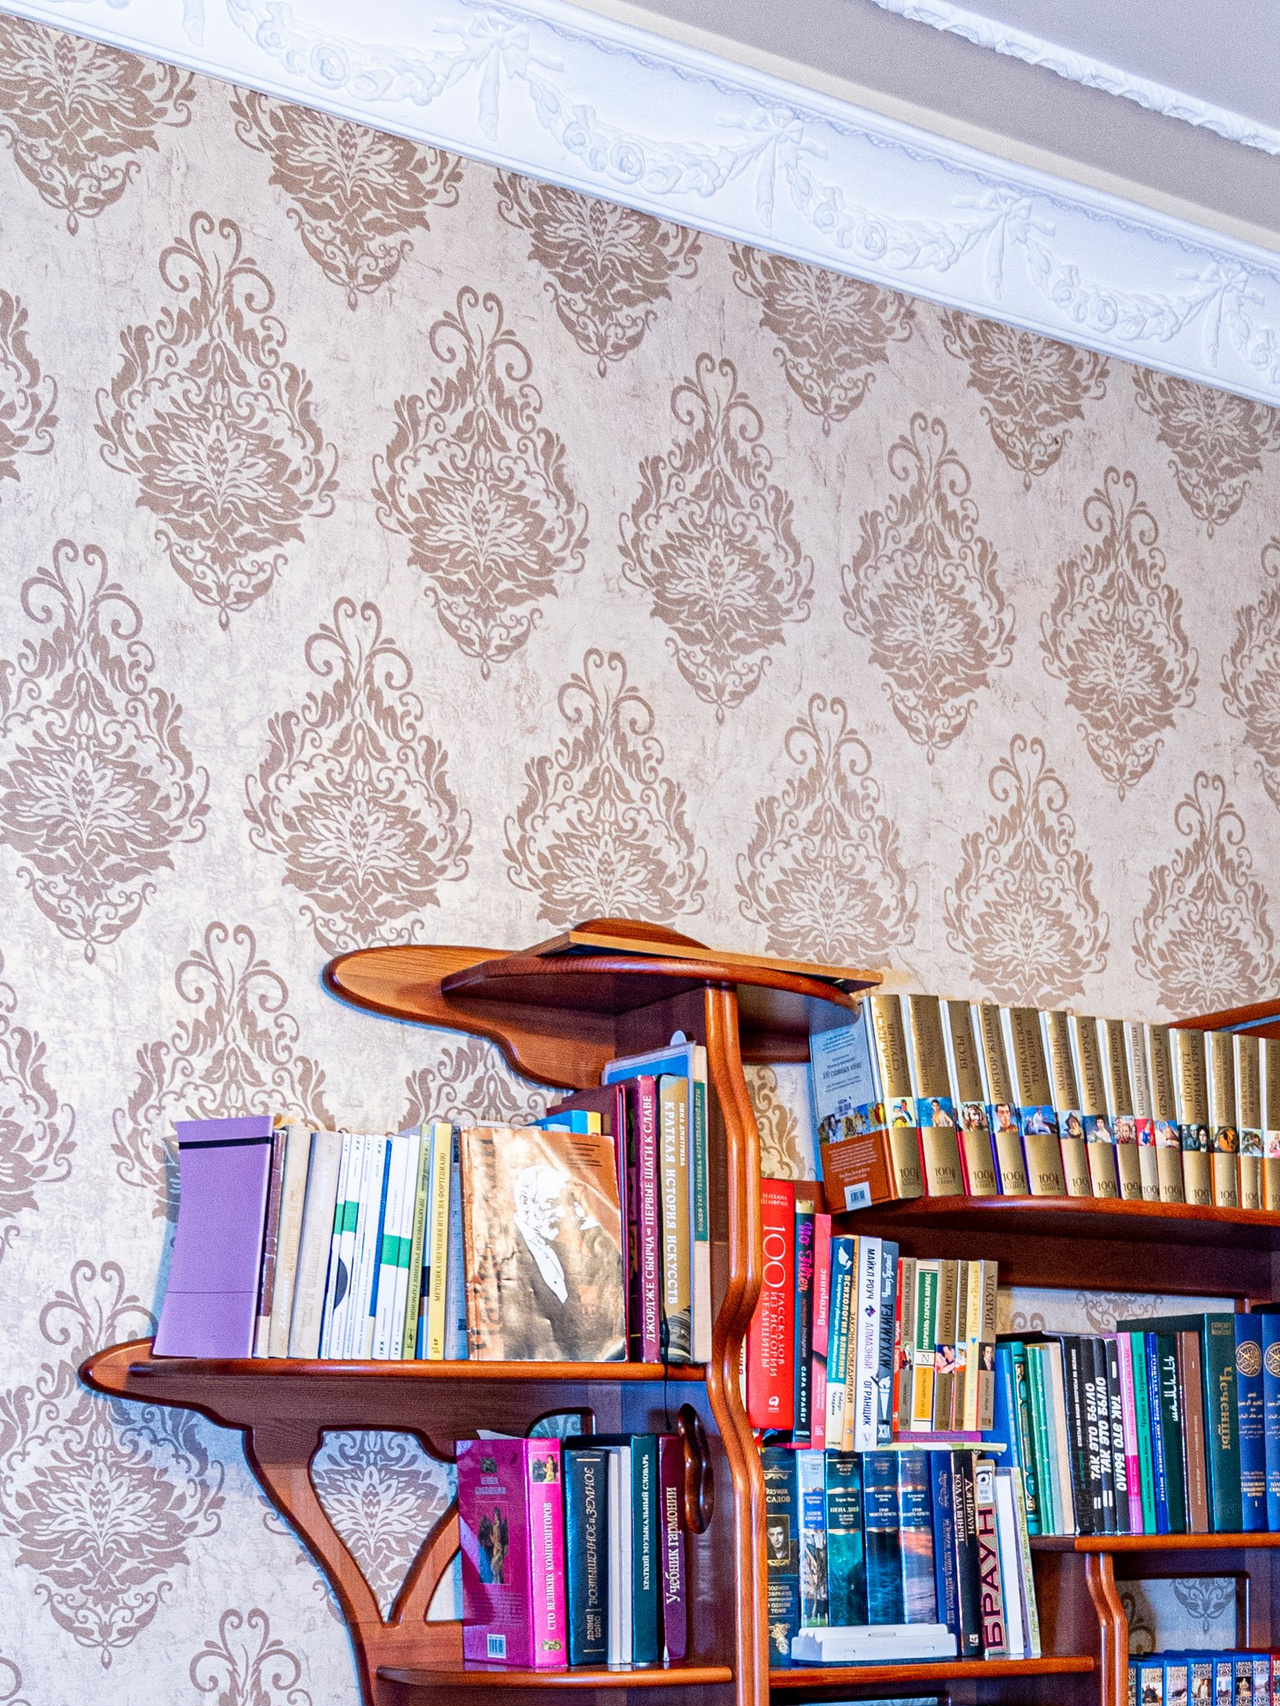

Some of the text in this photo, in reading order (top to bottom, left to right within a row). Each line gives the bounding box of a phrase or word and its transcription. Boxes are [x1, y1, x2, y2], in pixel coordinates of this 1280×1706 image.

[956, 1036, 969, 1069] БЕСЫ
[983, 1008, 1003, 1100] ДОКТОР ЖИВАГО
[1014, 1013, 1032, 1100] АМЕРИКАНСКАЯ
[1080, 1024, 1098, 1109] АЛЫЕ ПАРУСА
[1110, 1025, 1125, 1111] РАКОВЫЙ КОРПУС
[1154, 1049, 1168, 1116] GENERATION
[1182, 1051, 1194, 1102] ПОРТРЕТ
[1190, 1034, 1203, 1119] ДОРИАНА ГРЕЯ
[434, 1152, 446, 1301] МЕТОДИКА ОБУЧЕНИЯ ИГРЕ ФОРТЕПИАНО
[643, 1095, 656, 1343] ДЖОРДЖЕ СБЫРЧА ПЕРВЫЕ ШАГИ К СЛАВЕ
[665, 1101, 678, 1304] КРАТКАЯ ИСТОРИЯ ИСКУССТВ
[763, 1226, 786, 1287] 100
[797, 1250, 812, 1293] Filter
[866, 1248, 875, 1299] МАЙКЛ РОУЧ
[761, 1291, 769, 1368] МЕДИЦИНЫ
[770, 1291, 778, 1377] ИЗ ИСТОРИИ
[777, 1291, 785, 1364] РАССКАЗОВ
[838, 1274, 851, 1379] ПСИХОЛОГИЯ ВЛИЯНИЯ
[880, 1303, 893, 1369] МУХАММЕД
[984, 1274, 995, 1330] ДРАКУЛА
[799, 1365, 808, 1423] САРА ФРАЙЕР
[862, 1322, 875, 1426] АЛМАЗНЫЙ ОГРАНЩИК
[1085, 1383, 1096, 1421] БЫЛО
[1218, 1366, 1232, 1450] Чеченцы
[1088, 1426, 1099, 1451] ЭТО
[1095, 1377, 1112, 1474] ТАК ЭТО БЫЛО
[1110, 1395, 1127, 1491] ТАК ЭТО БЫЛО
[964, 1478, 975, 1535] ДЭН БРАУН
[1090, 1456, 1102, 1480] ТАК
[544, 1503, 556, 1630] СТО ВЕЛИКИХ КОМПОЗИТОРОВ
[584, 1467, 598, 1606] ВОЗВЫШЕННОЕ ЗЕМНОЕ
[642, 1555, 650, 1590] КРАТКИЙ
[664, 1487, 681, 1605] Учебник гармонии
[977, 1507, 1005, 1648] БРАУН
